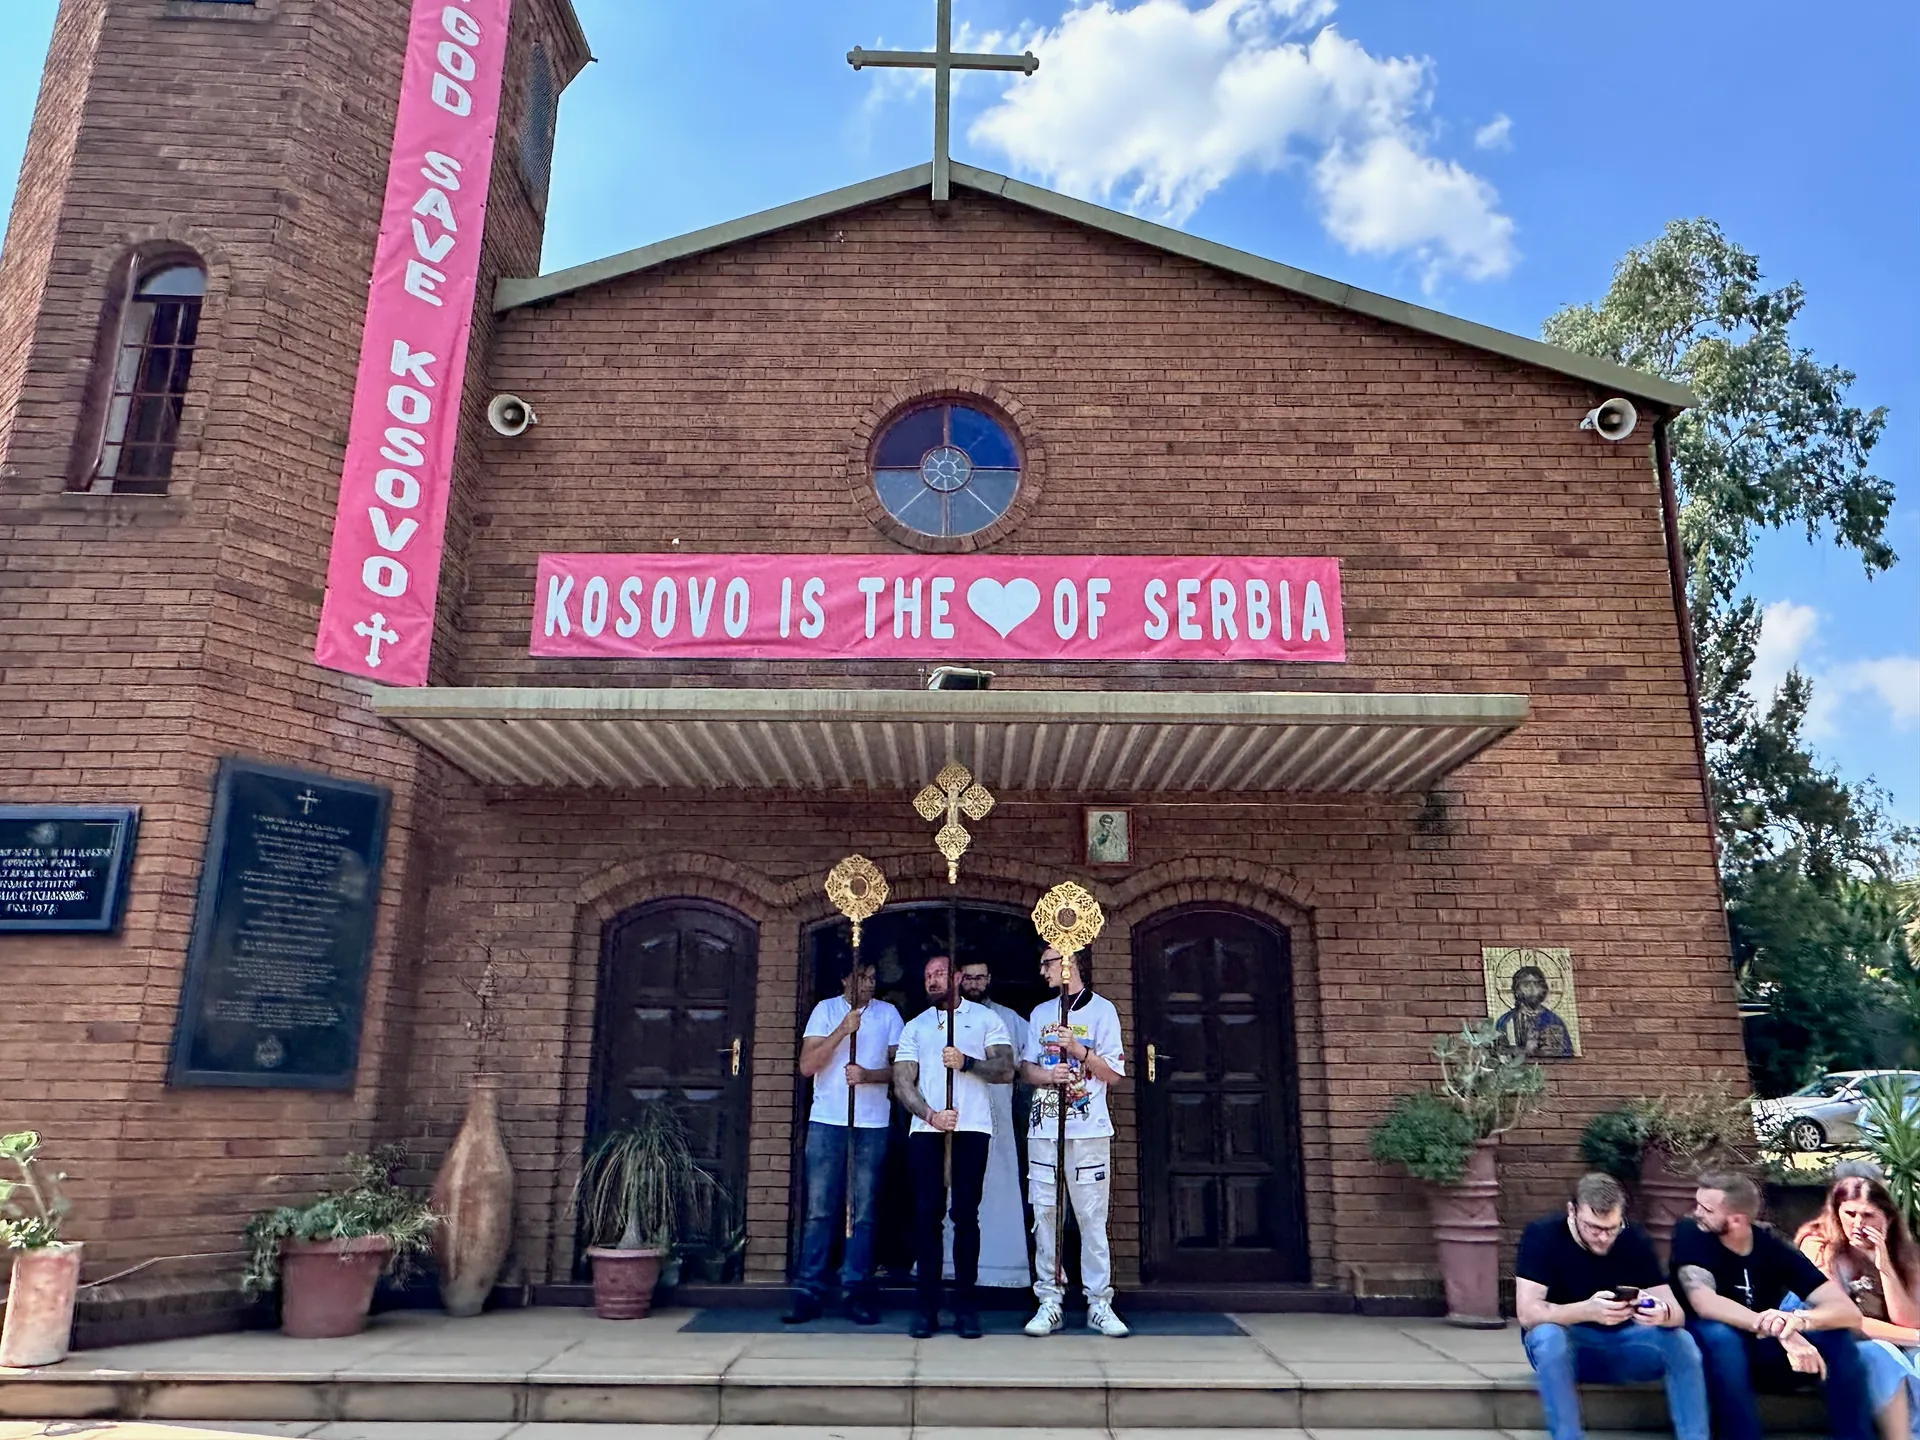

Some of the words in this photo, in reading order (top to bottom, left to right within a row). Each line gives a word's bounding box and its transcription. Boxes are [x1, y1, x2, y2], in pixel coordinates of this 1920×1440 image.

[430, 5, 481, 117] GOD
[404, 150, 462, 307] SAVE
[361, 339, 437, 598] KOSOVO
[544, 574, 750, 639] KOSOVO
[779, 576, 826, 639] IS
[857, 576, 956, 640] THE
[1053, 577, 1111, 640] OF
[1143, 578, 1331, 642] SERBIA
